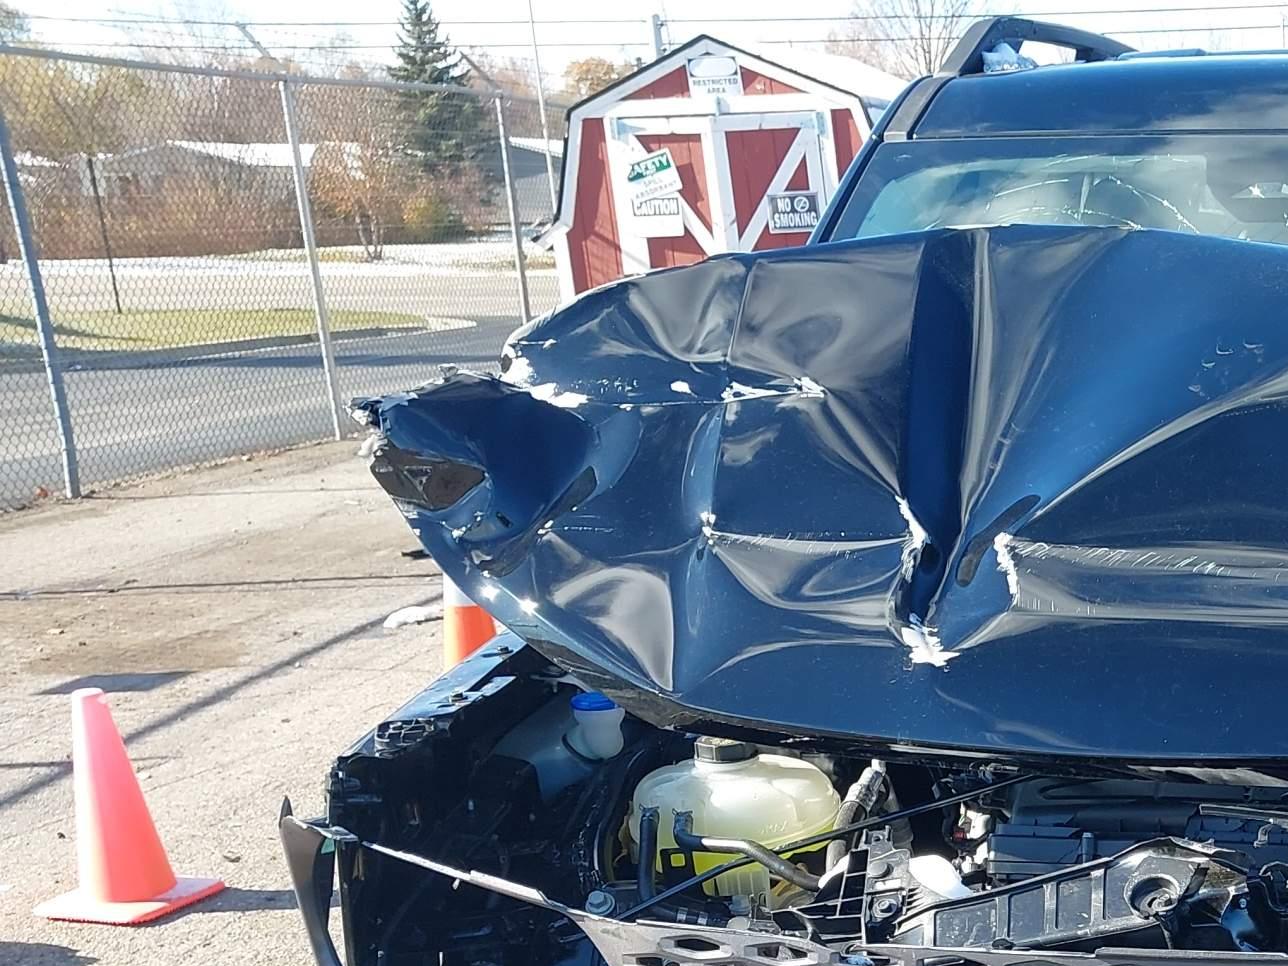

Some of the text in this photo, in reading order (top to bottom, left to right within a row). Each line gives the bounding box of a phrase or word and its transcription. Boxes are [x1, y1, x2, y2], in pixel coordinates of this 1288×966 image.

[692, 78, 738, 86] RESTRICTED
[634, 198, 678, 216] CAUTION
[777, 198, 791, 212] NO
[774, 211, 817, 228] SMOKING
